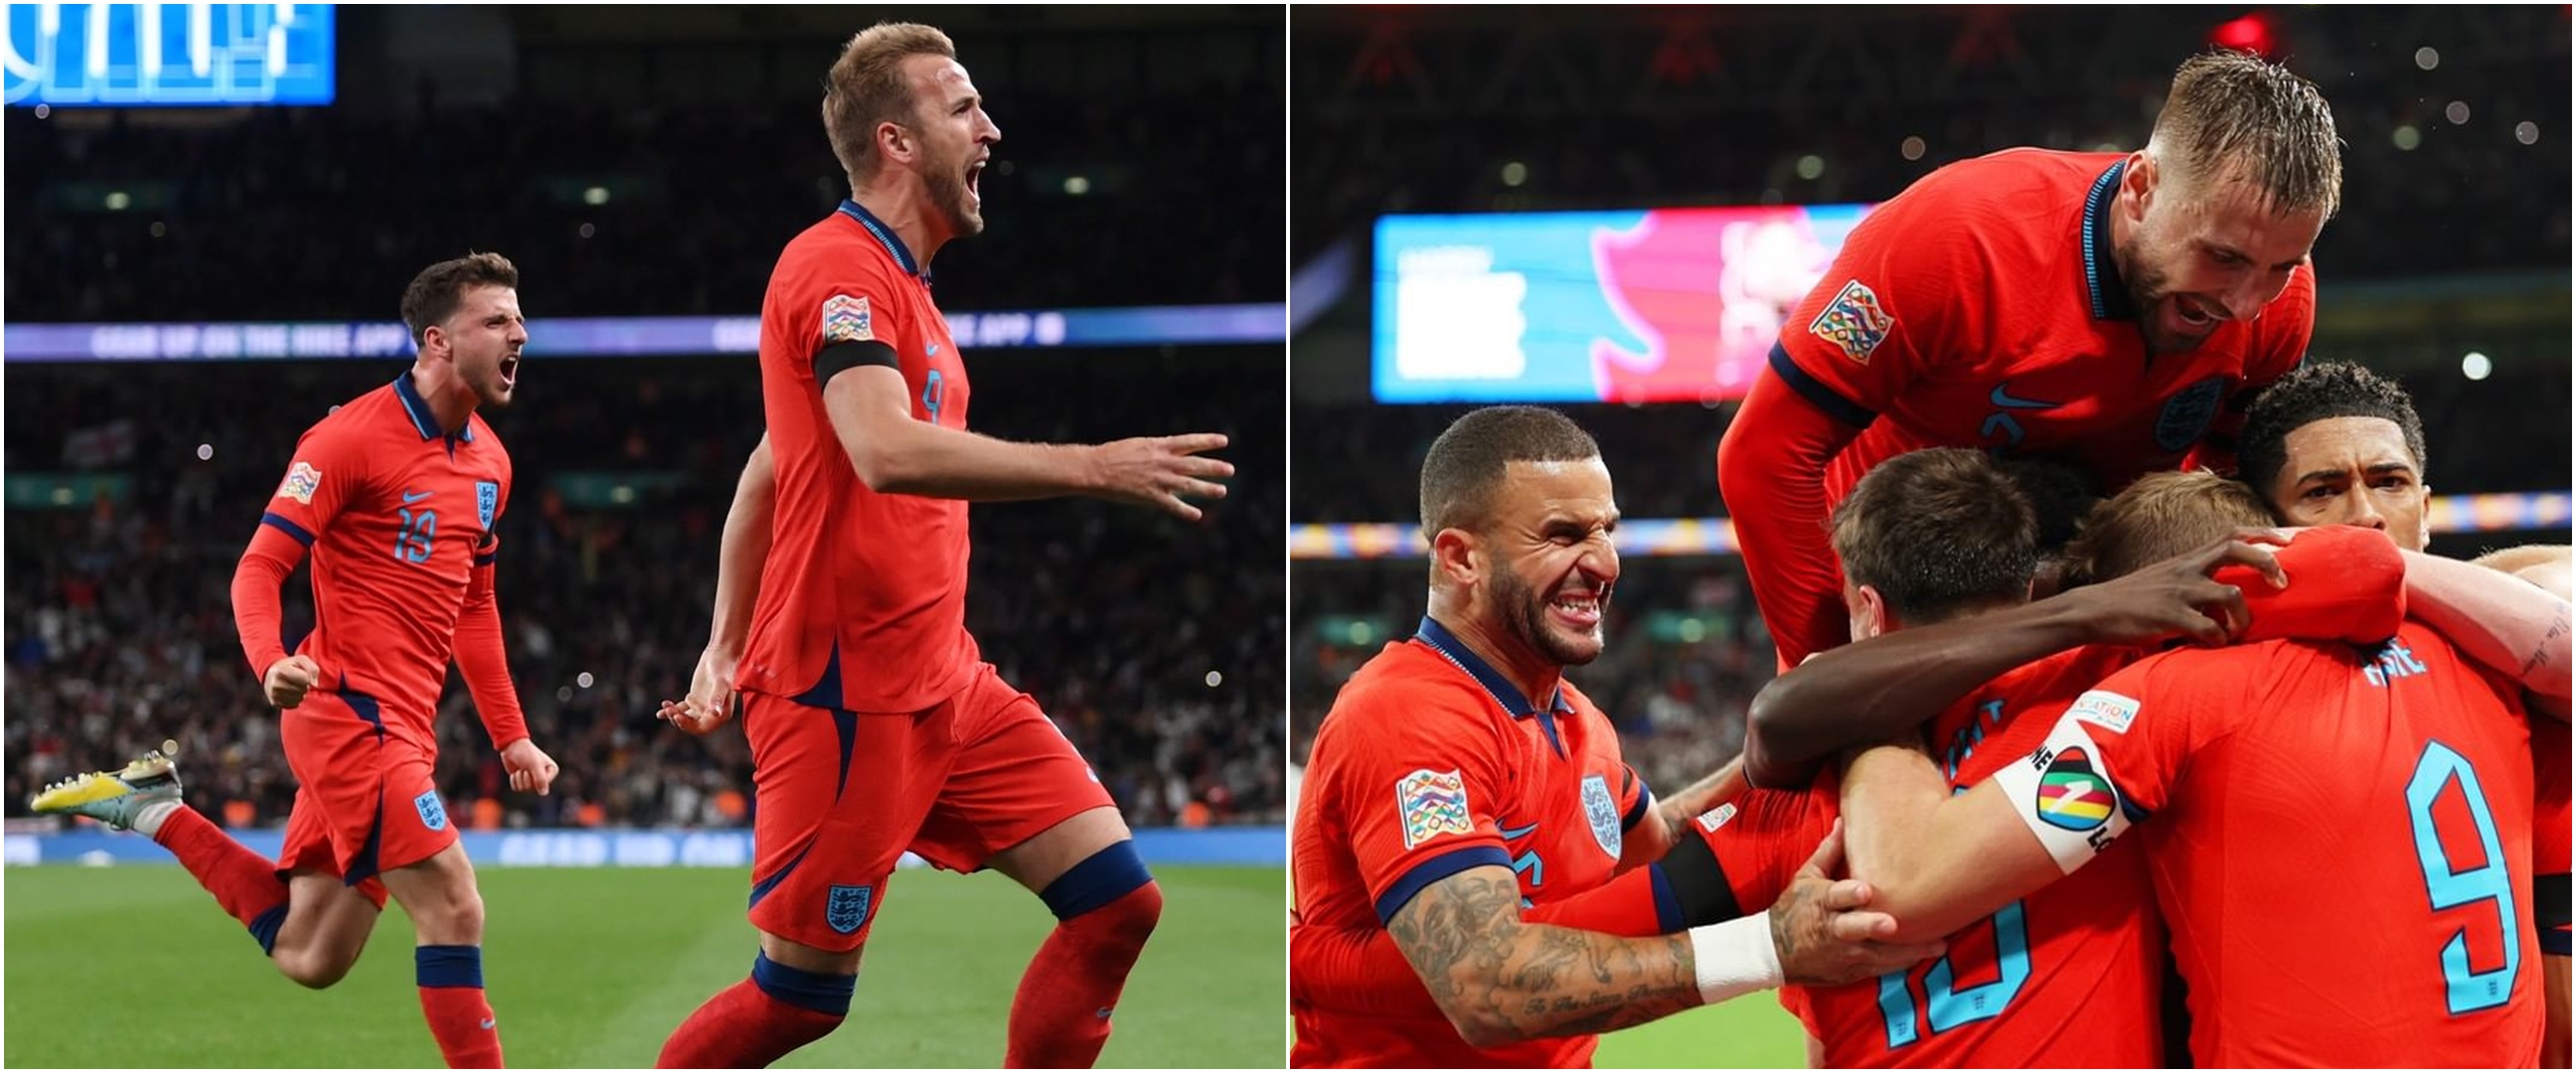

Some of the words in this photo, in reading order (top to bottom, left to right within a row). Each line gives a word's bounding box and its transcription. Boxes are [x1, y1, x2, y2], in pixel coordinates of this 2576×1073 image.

[922, 369, 943, 425] 9
[395, 508, 436, 563] 19
[2404, 738, 2521, 1016] 9
